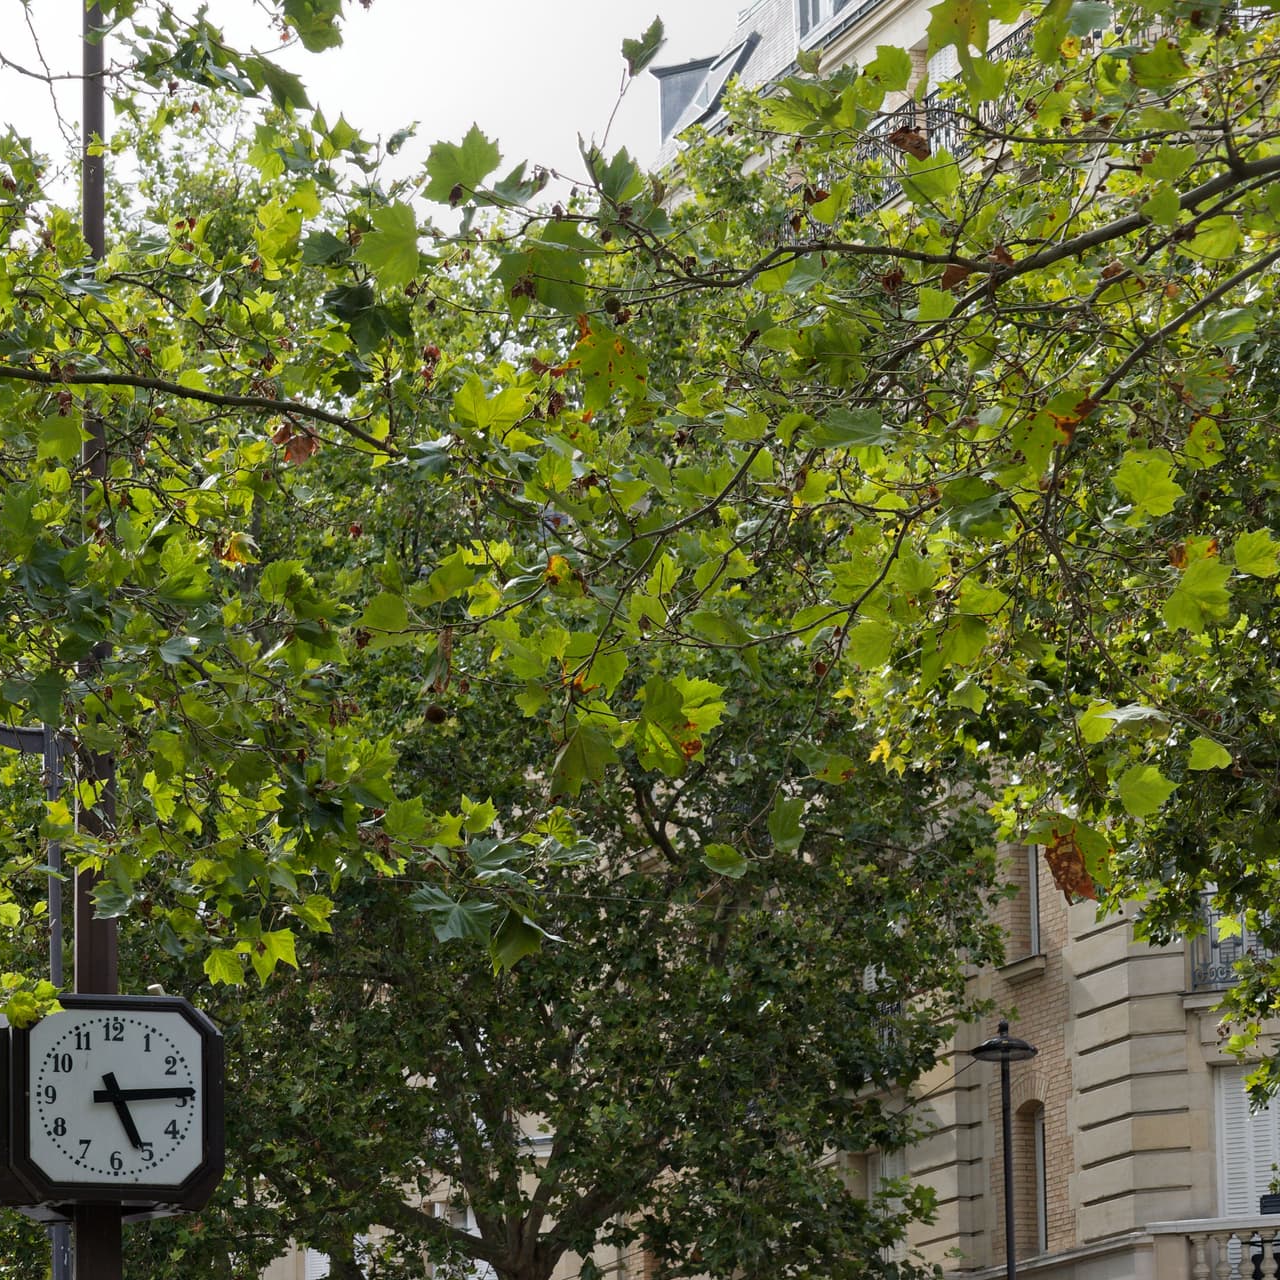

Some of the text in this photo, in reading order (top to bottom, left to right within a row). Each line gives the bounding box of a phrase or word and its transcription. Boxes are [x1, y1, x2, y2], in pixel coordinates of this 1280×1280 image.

[74, 1031, 92, 1051] 11
[102, 1022, 125, 1042] 12
[143, 1033, 152, 1053] 1
[52, 1053, 73, 1073] 10
[164, 1055, 178, 1076] 2
[44, 1085, 57, 1105] 9
[52, 1117, 67, 1137] 8
[163, 1119, 181, 1140] 4
[78, 1139, 92, 1160] 7
[140, 1142, 154, 1162] 5
[109, 1150, 123, 1171] 6
